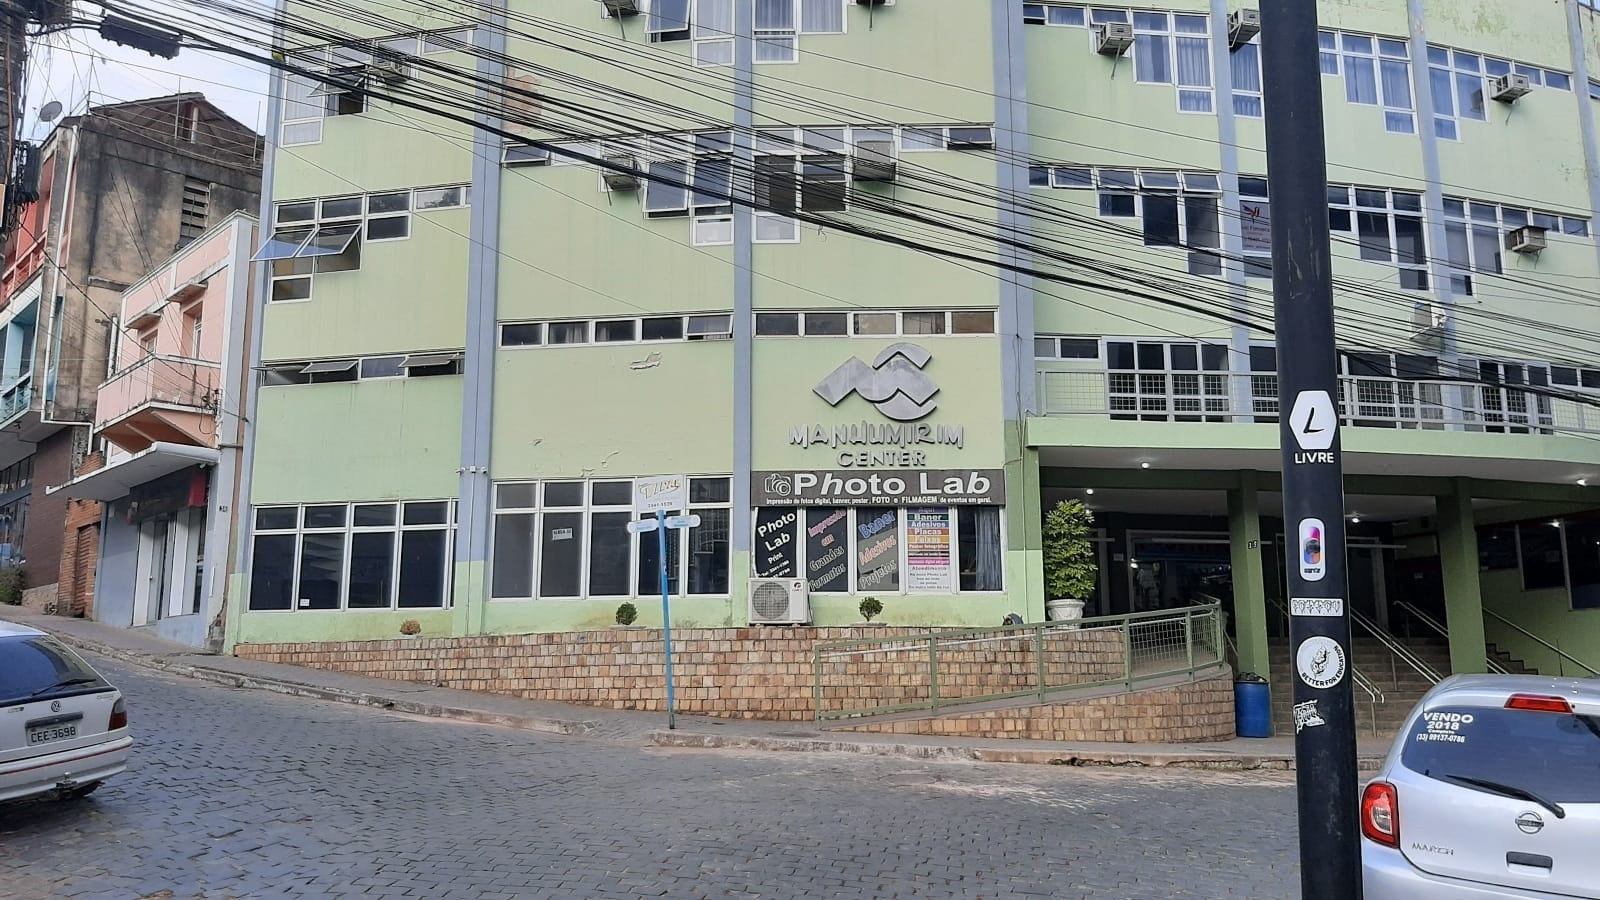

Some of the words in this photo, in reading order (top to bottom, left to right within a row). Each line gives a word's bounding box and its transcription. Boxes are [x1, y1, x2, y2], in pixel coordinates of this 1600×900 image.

[837, 450, 927, 467] CENTER
[1294, 452, 1335, 464] LIVRE
[794, 472, 906, 496] Photo
[919, 471, 991, 495] Lab
[872, 496, 890, 504] FOTO
[902, 495, 937, 504] FILMAGEM
[757, 513, 796, 537] Photo
[858, 511, 896, 538] Baner
[765, 532, 790, 551] Lab
[821, 534, 835, 546] em
[767, 552, 784, 564] Print
[809, 546, 845, 571] Grandes
[859, 534, 897, 566] Adesivos
[808, 563, 846, 591] Formatos
[859, 560, 897, 589] Projetos
[1301, 671, 1325, 687] BETTER
[1423, 712, 1474, 723] VENDO
[1426, 721, 1460, 730] 2018
[30, 726, 77, 743] CEE-3698
[1416, 733, 1428, 742] (33)
[1411, 842, 1454, 856] MARCH
